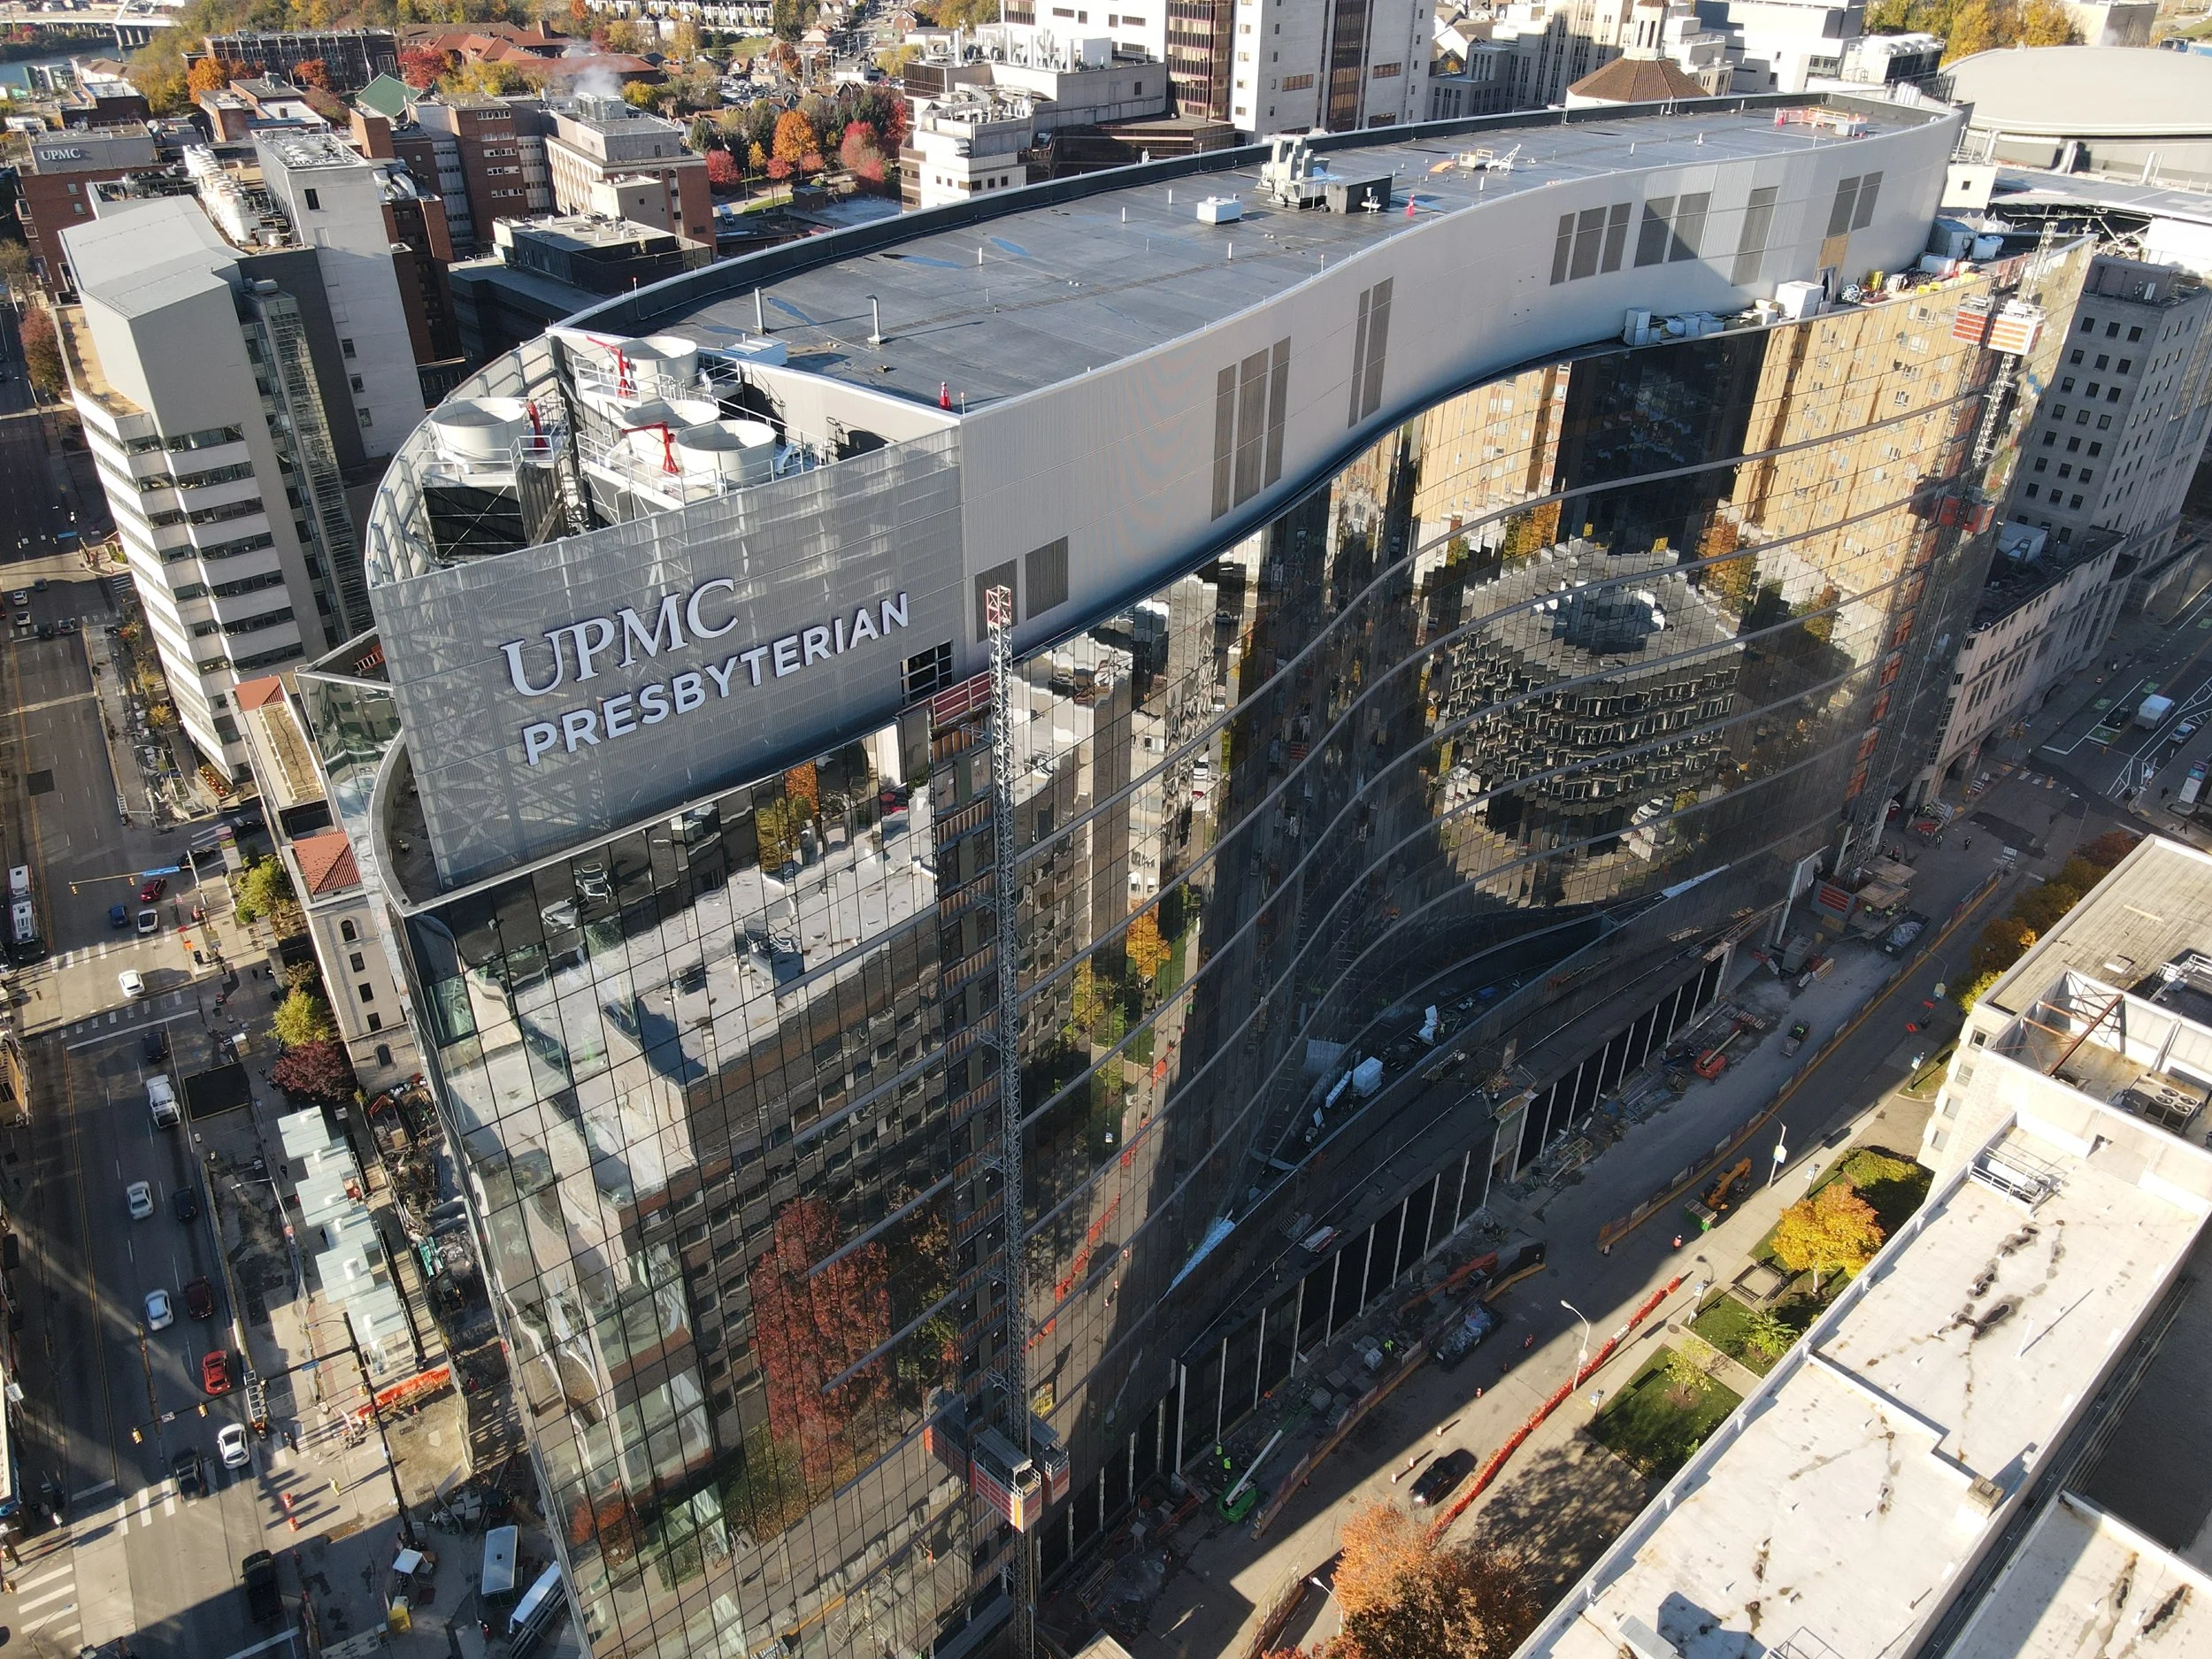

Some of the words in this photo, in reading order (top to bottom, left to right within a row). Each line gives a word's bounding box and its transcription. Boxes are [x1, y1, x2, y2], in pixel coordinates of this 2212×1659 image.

[40, 149, 81, 161] UPMC
[500, 578, 739, 697] UPMC
[523, 592, 910, 766] PRESBYTERIAN
